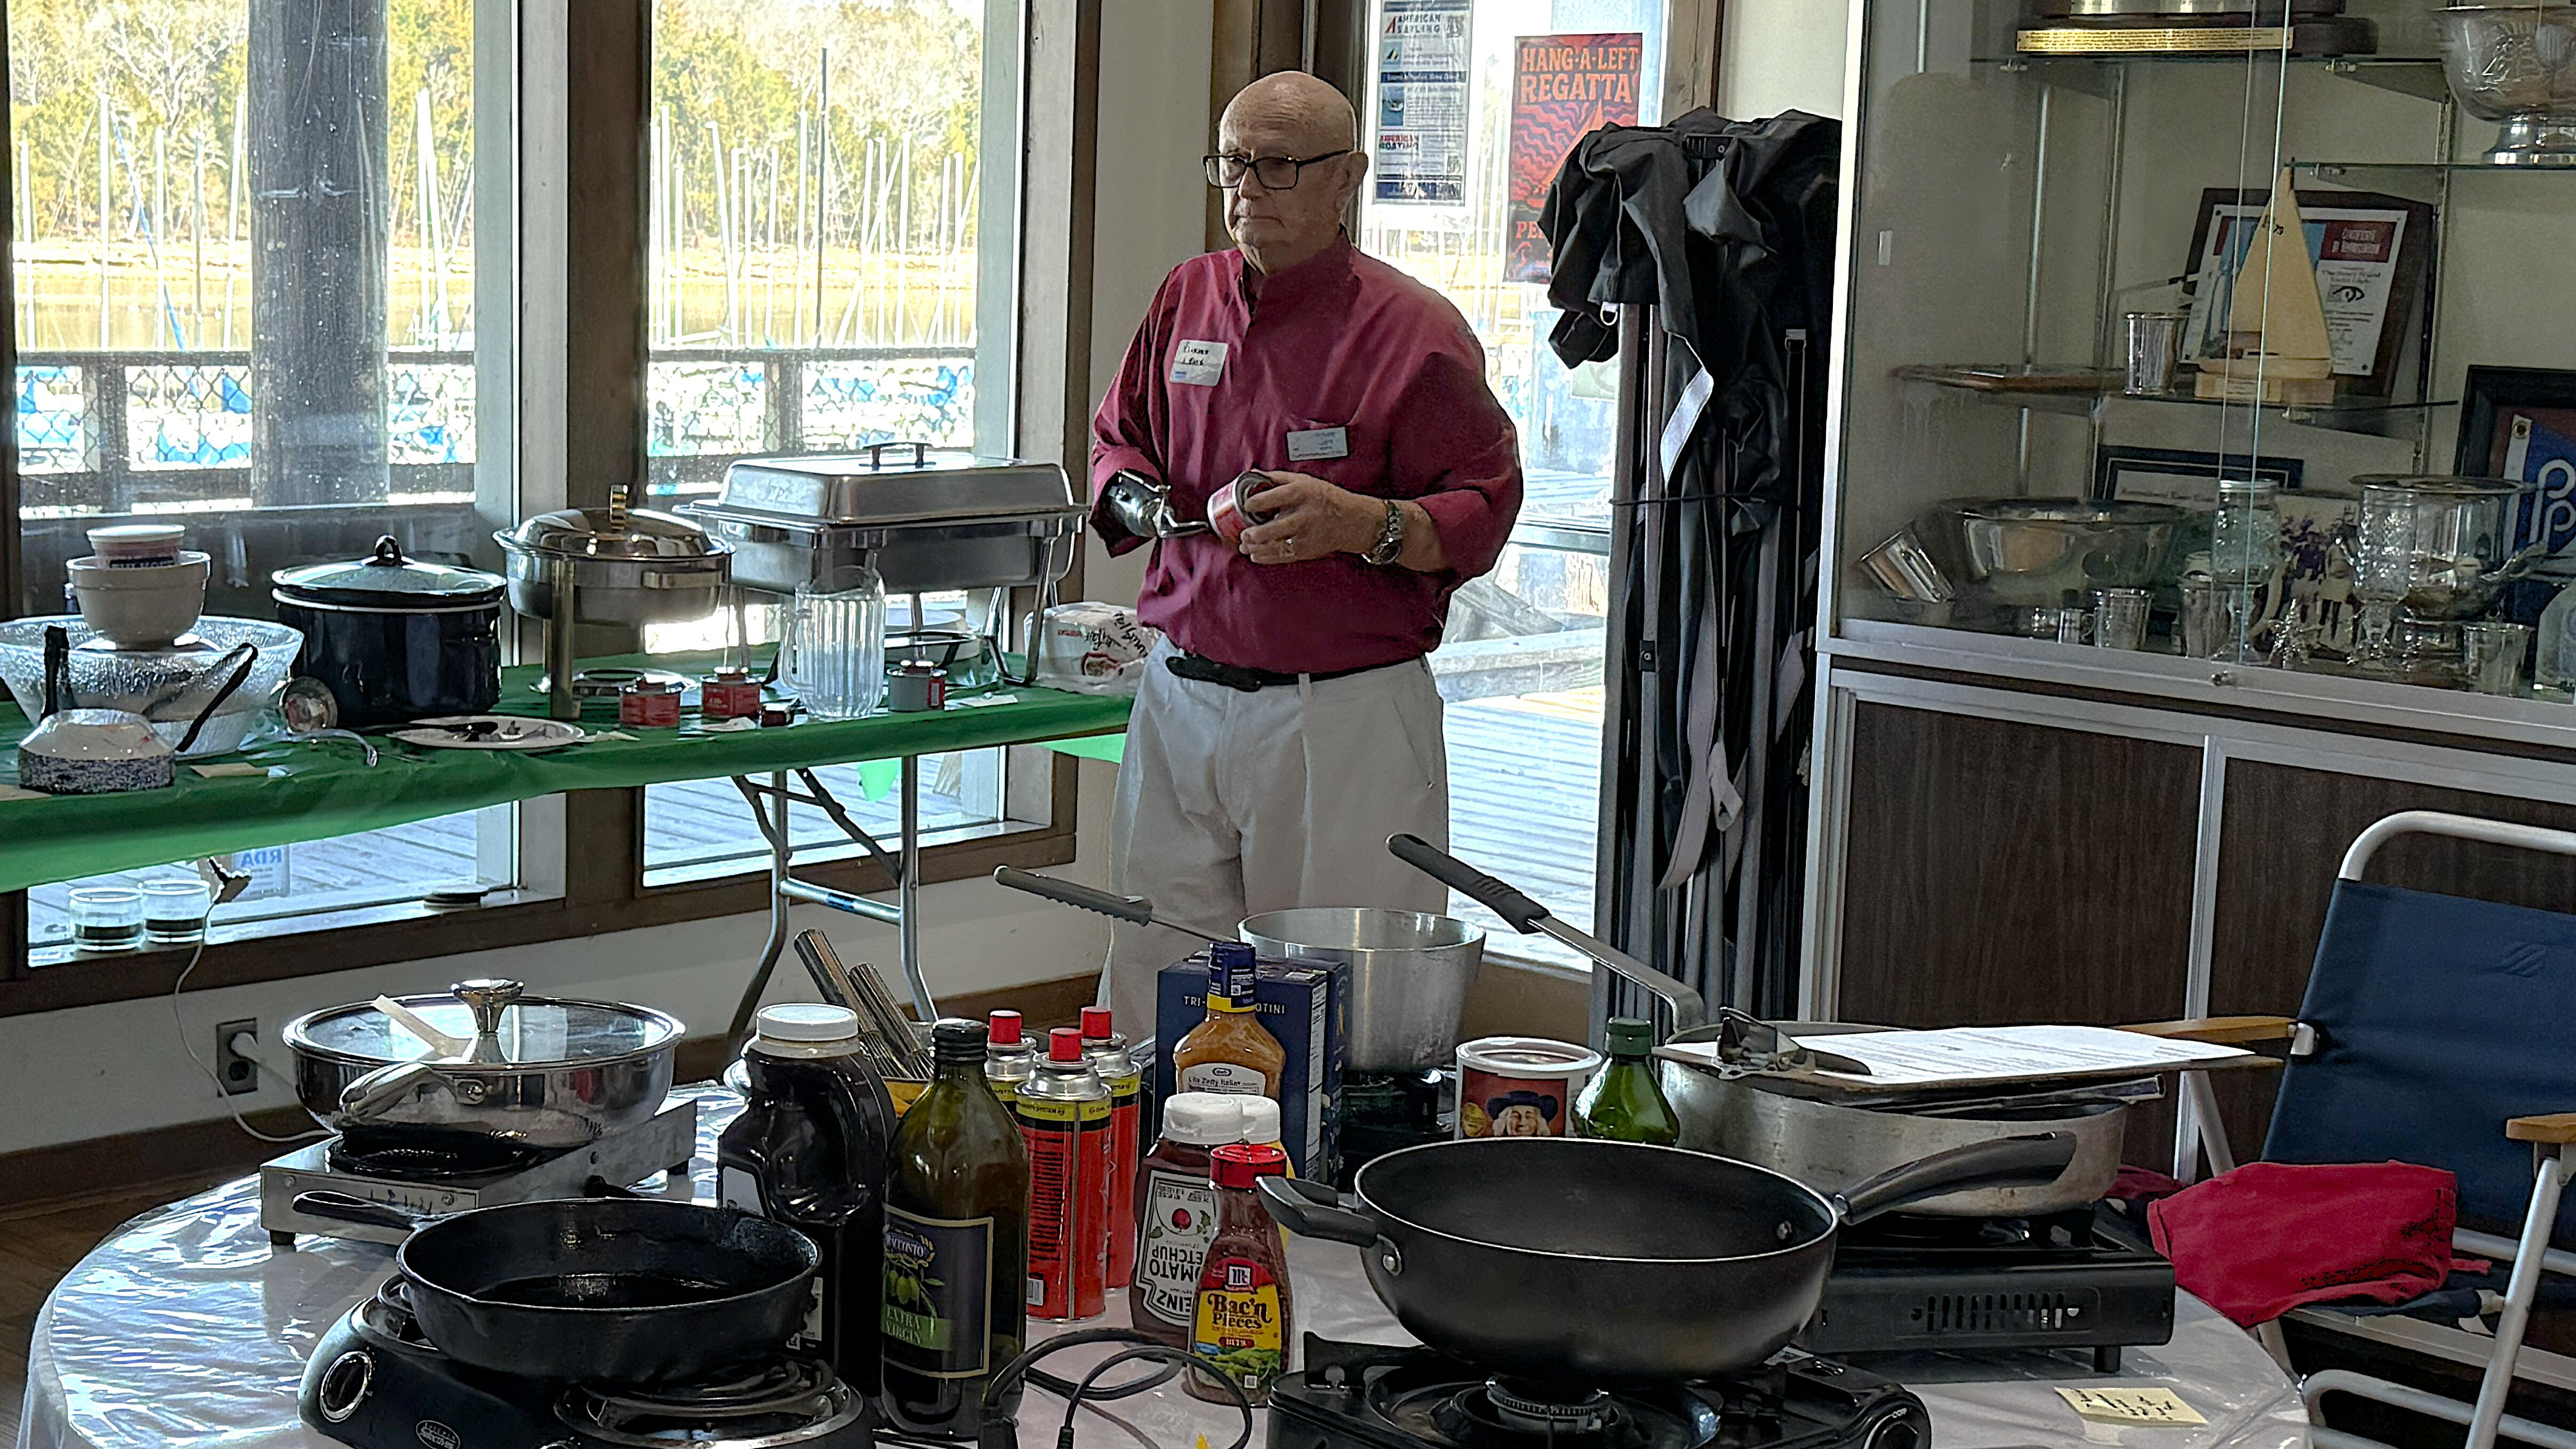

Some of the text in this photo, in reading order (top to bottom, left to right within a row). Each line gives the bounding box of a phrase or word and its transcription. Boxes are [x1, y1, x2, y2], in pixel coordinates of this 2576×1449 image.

[1521, 73, 1633, 104] REGATTA
[1256, 1003, 1285, 1014] OTINI
[1151, 1245, 1203, 1265] ETCHUP
[1149, 1258, 1201, 1283] MATO
[1156, 1288, 1192, 1313] EINZ
[1213, 1312, 1262, 1329] Pieces
